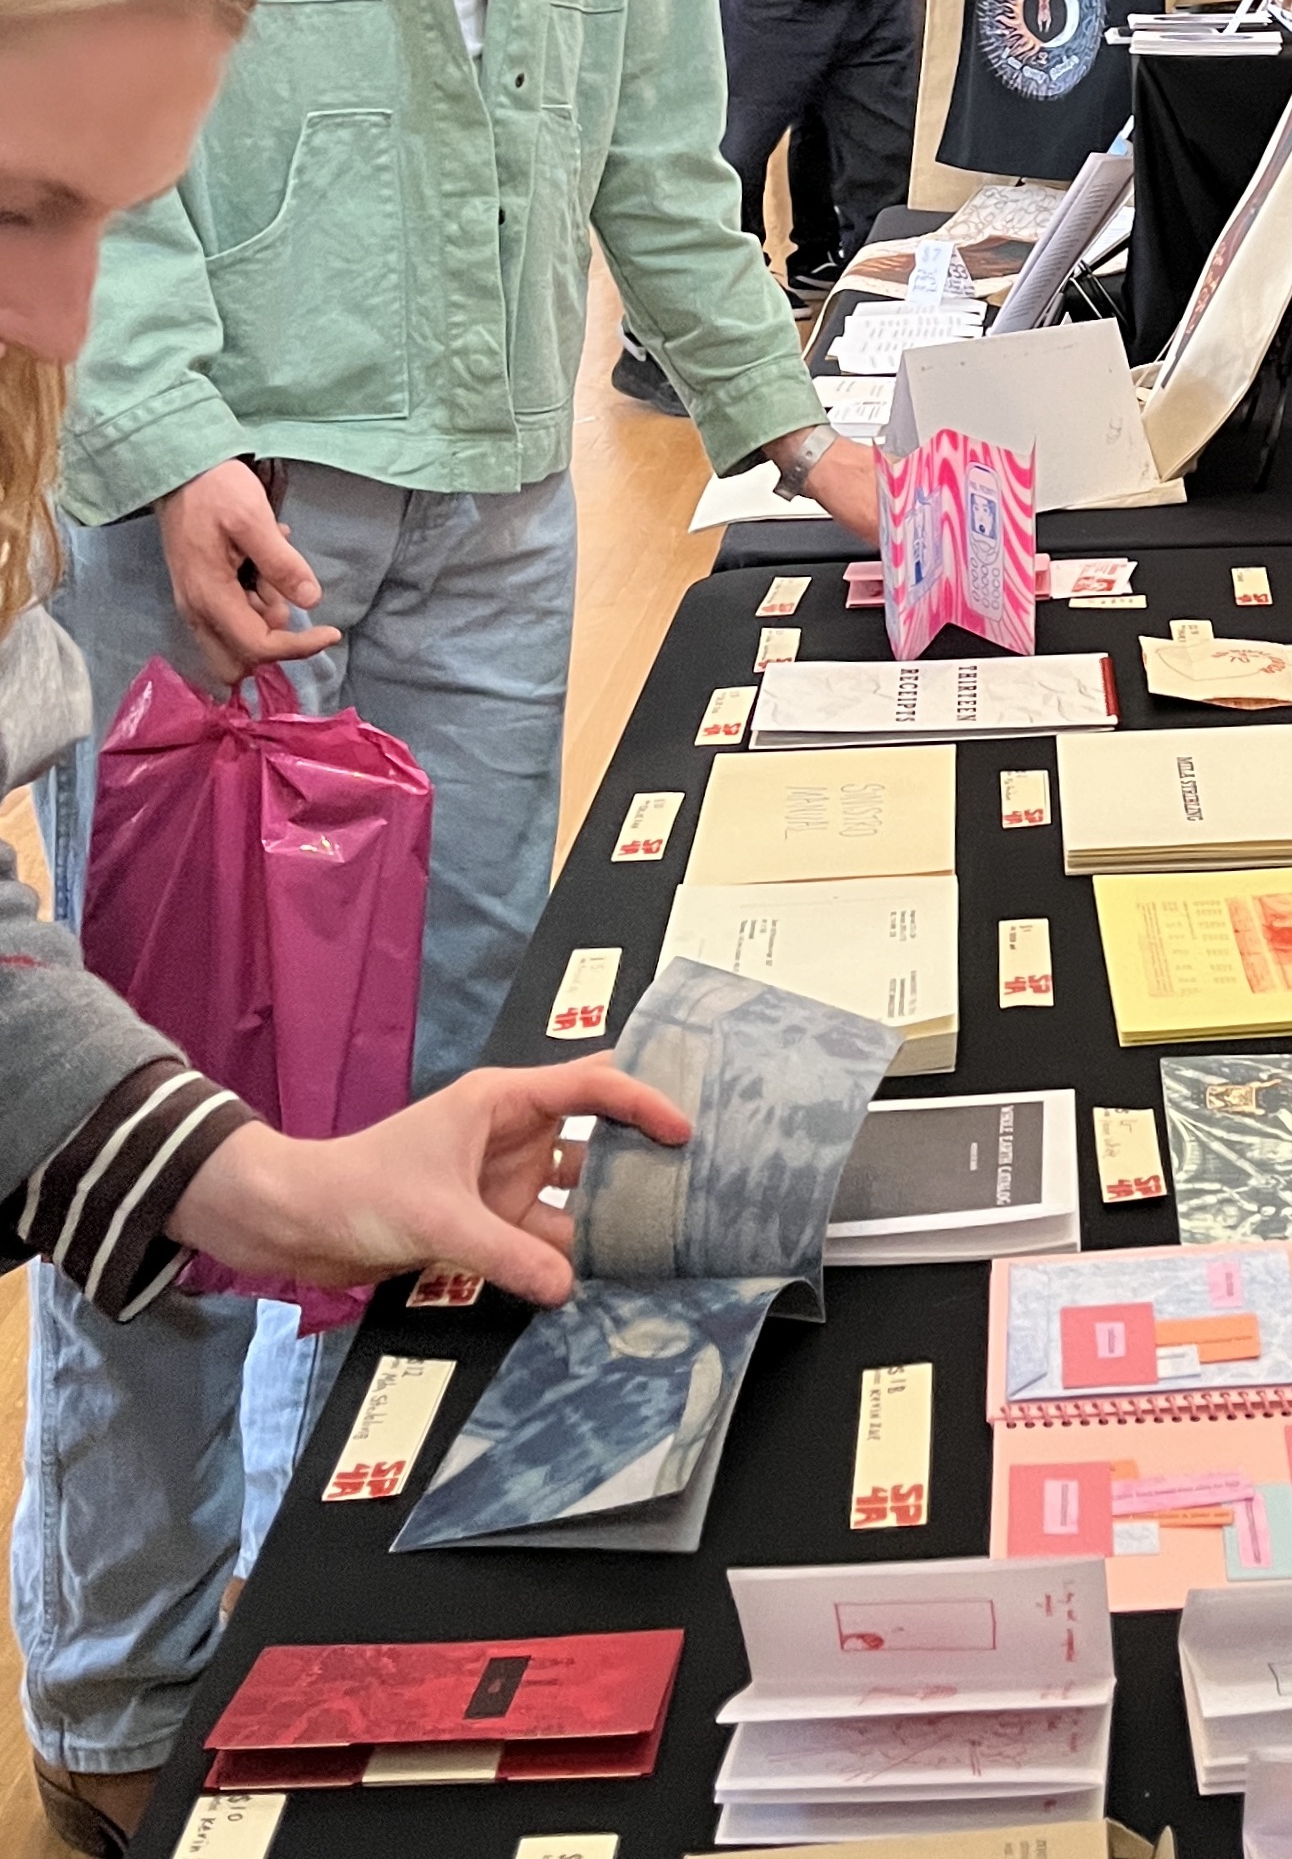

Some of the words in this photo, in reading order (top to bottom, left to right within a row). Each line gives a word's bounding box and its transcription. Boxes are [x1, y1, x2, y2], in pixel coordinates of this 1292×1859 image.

[895, 668, 919, 723] RECEIPTS
[957, 665, 978, 722] THIRTEEN
[1176, 756, 1196, 779] MILA
[784, 785, 830, 840] MANUAL
[1179, 780, 1204, 822] STRIBLING
[996, 1165, 1012, 1206] CATALOG
[331, 1464, 368, 1499] 4A
[367, 1459, 405, 1498] SP
[855, 1486, 889, 1528] 4A
[889, 1483, 924, 1527] SP
[190, 1817, 217, 1853] Kevin
